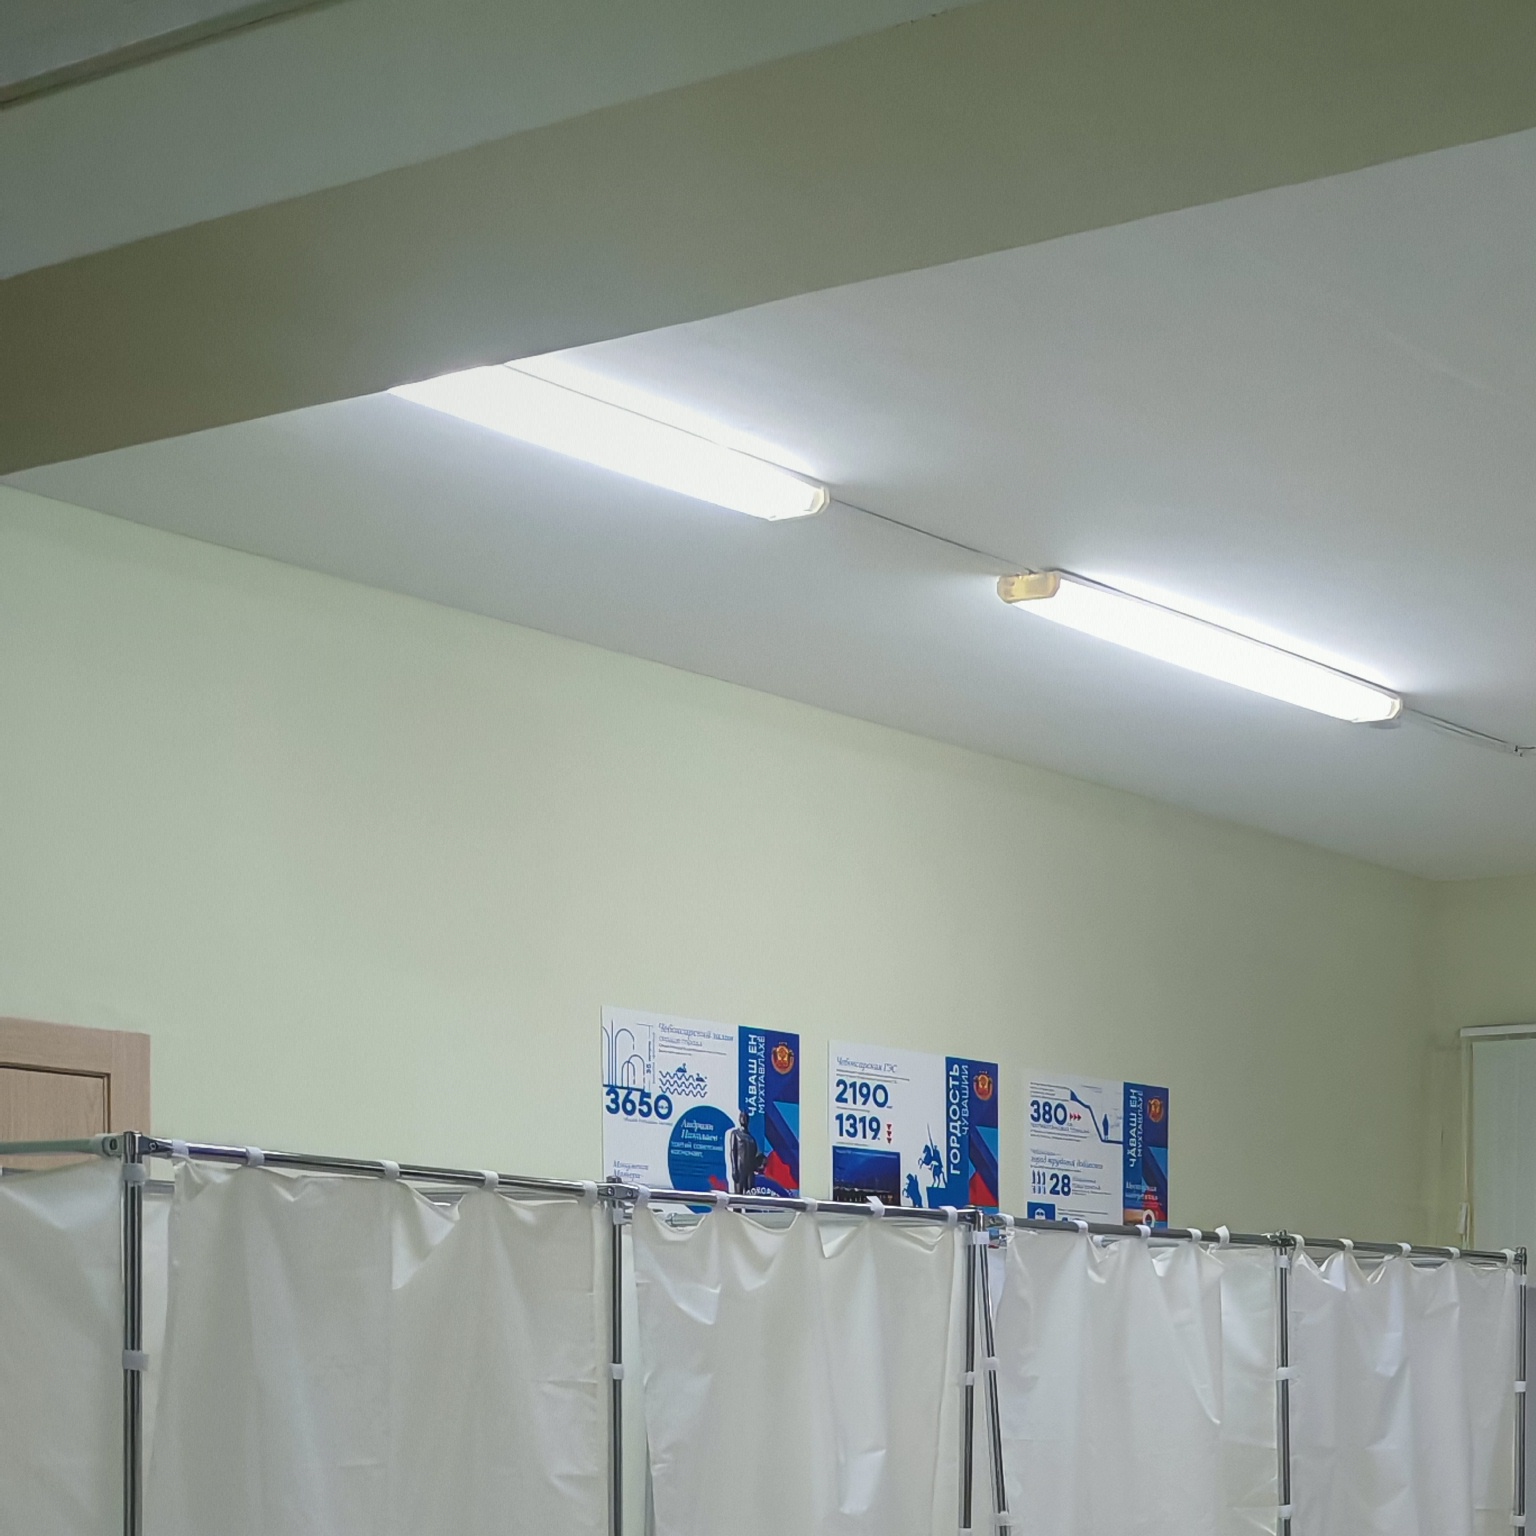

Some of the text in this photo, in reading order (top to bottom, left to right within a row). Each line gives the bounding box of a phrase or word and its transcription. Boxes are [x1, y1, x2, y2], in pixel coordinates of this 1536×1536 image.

[748, 1034, 757, 1054] ЕН
[605, 1087, 673, 1120] 3650
[835, 1078, 889, 1109] 2190
[960, 1064, 970, 1136] ЧУВАШИИ
[835, 1112, 881, 1141] 1319
[949, 1063, 961, 1175] ГОРДОСТЬ
[1030, 1099, 1068, 1126] 380
[1049, 1172, 1072, 1197] 28
